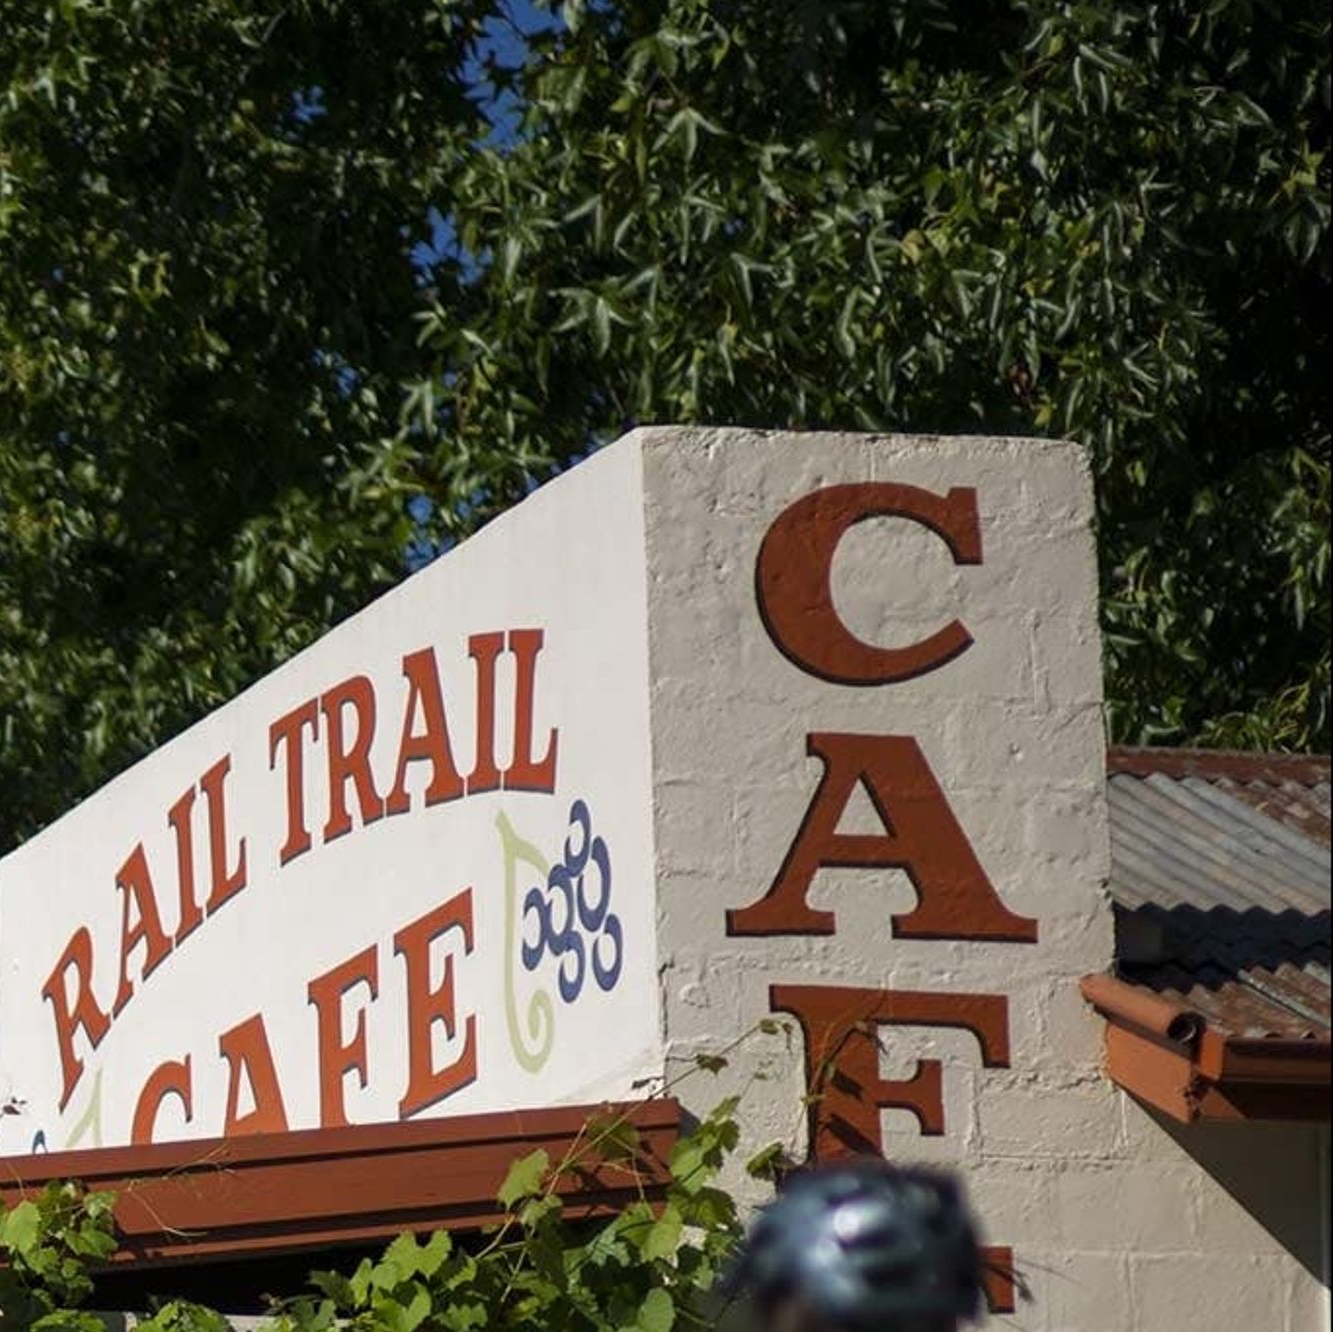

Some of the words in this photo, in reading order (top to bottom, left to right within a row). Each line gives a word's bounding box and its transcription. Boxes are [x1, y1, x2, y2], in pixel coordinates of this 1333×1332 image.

[41, 752, 247, 1114] RAIL
[269, 627, 559, 867] TRAIL
[129, 886, 477, 1146] CAFE
